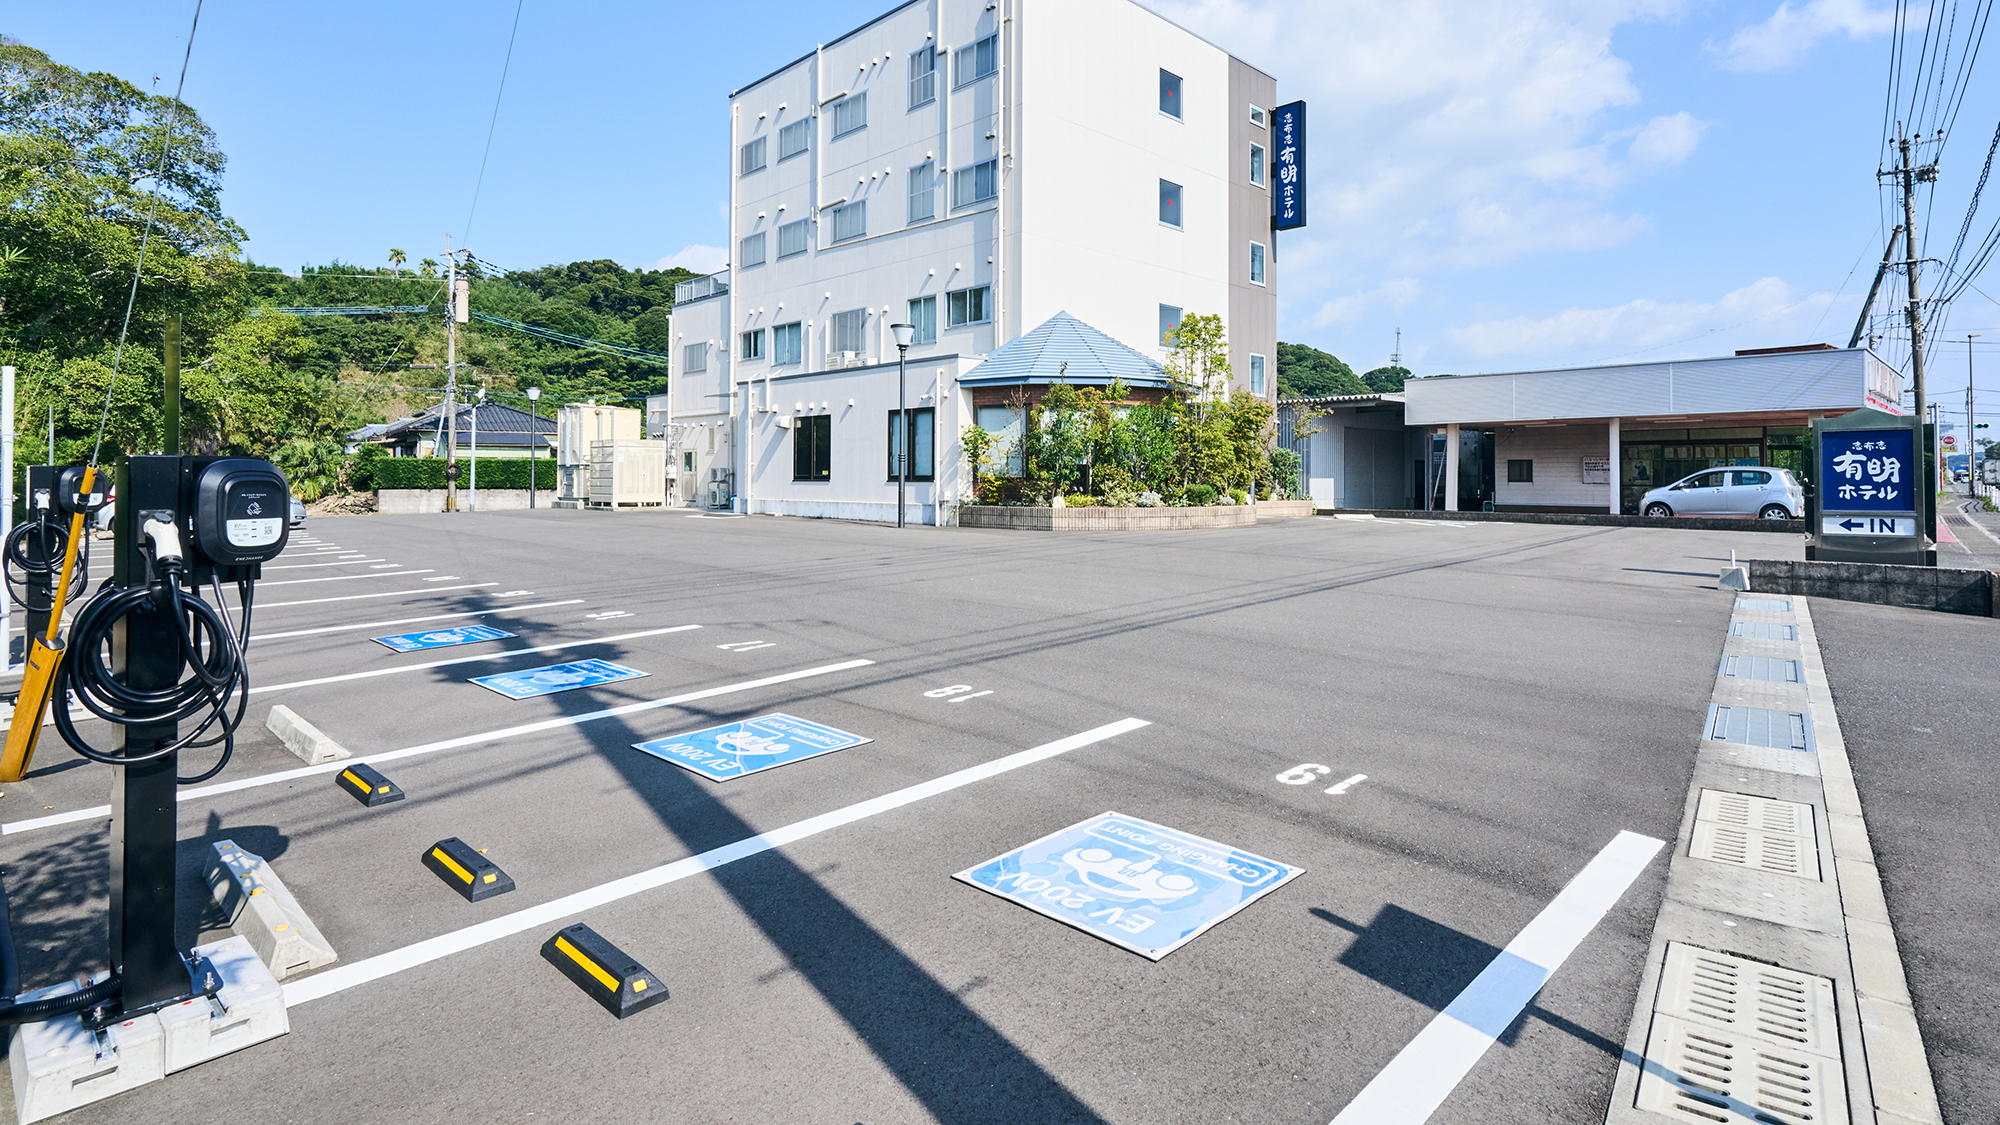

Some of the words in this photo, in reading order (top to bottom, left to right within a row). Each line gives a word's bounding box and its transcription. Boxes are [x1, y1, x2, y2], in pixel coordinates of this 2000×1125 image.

[1280, 112, 1298, 219] 志布志有明ホテル
[1852, 440, 1887, 451] 志布志
[1832, 450, 1901, 483] 有明
[1838, 484, 1898, 500] ホテル
[1870, 518, 1895, 533] IN
[923, 684, 994, 702] 18
[760, 719, 788, 731] POINT
[788, 727, 841, 745] CHARGING
[659, 742, 714, 761] 200V
[701, 758, 740, 771] EV
[1275, 763, 1368, 794] 19
[1103, 825, 1158, 845] POINT
[1157, 842, 1260, 878] CHARGING
[997, 871, 1096, 908] 200V
[1089, 907, 1156, 934] EV
